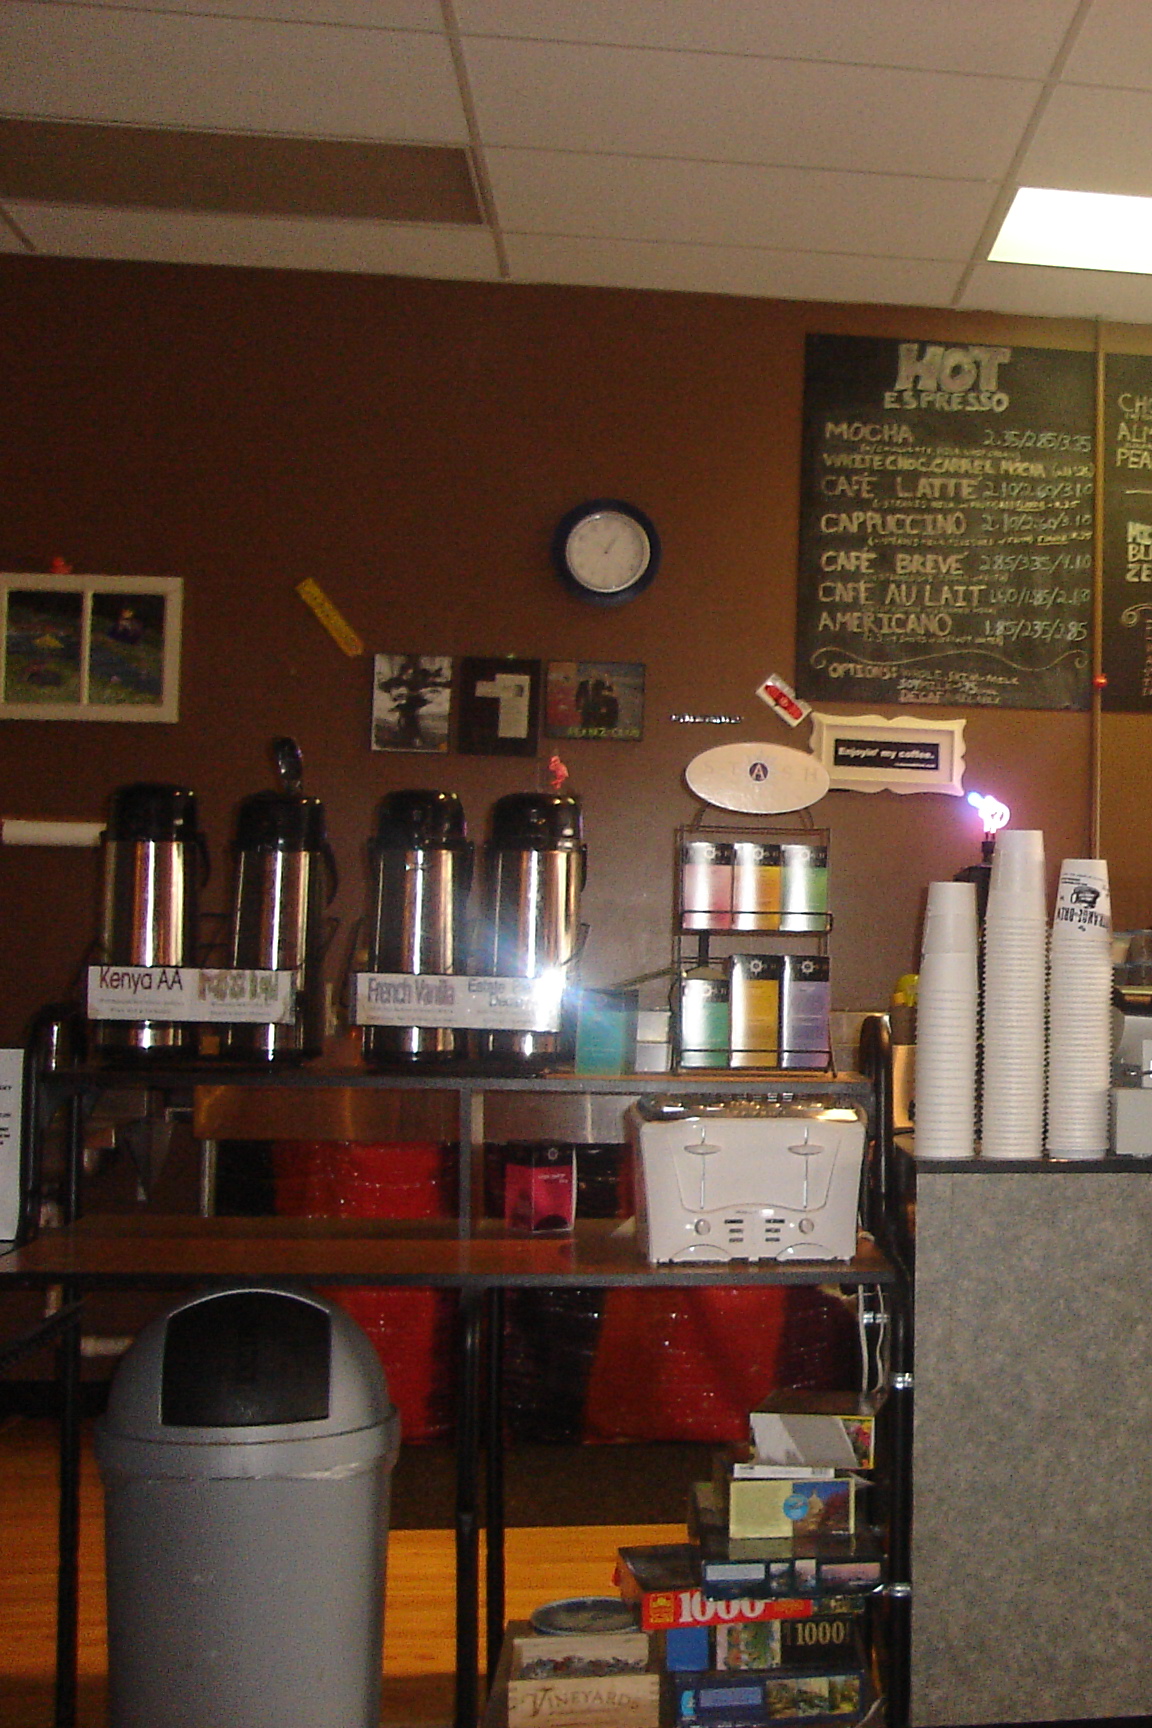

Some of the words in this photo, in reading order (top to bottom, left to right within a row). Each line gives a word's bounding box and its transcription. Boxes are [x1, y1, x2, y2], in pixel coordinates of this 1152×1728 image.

[894, 343, 1012, 391] HOT
[883, 391, 1010, 412] ESPRESSO
[825, 422, 914, 443] MOCHA
[1000, 459, 1046, 478] MOCHA
[820, 511, 967, 535] CAPPUCCINO
[885, 584, 915, 605] AU
[925, 584, 988, 606] LAIT
[818, 612, 953, 637] AMERICANO
[99, 966, 153, 995] Kenya
[157, 969, 183, 991] AA
[367, 977, 412, 1004] French
[796, 1621, 845, 1646] 1000
